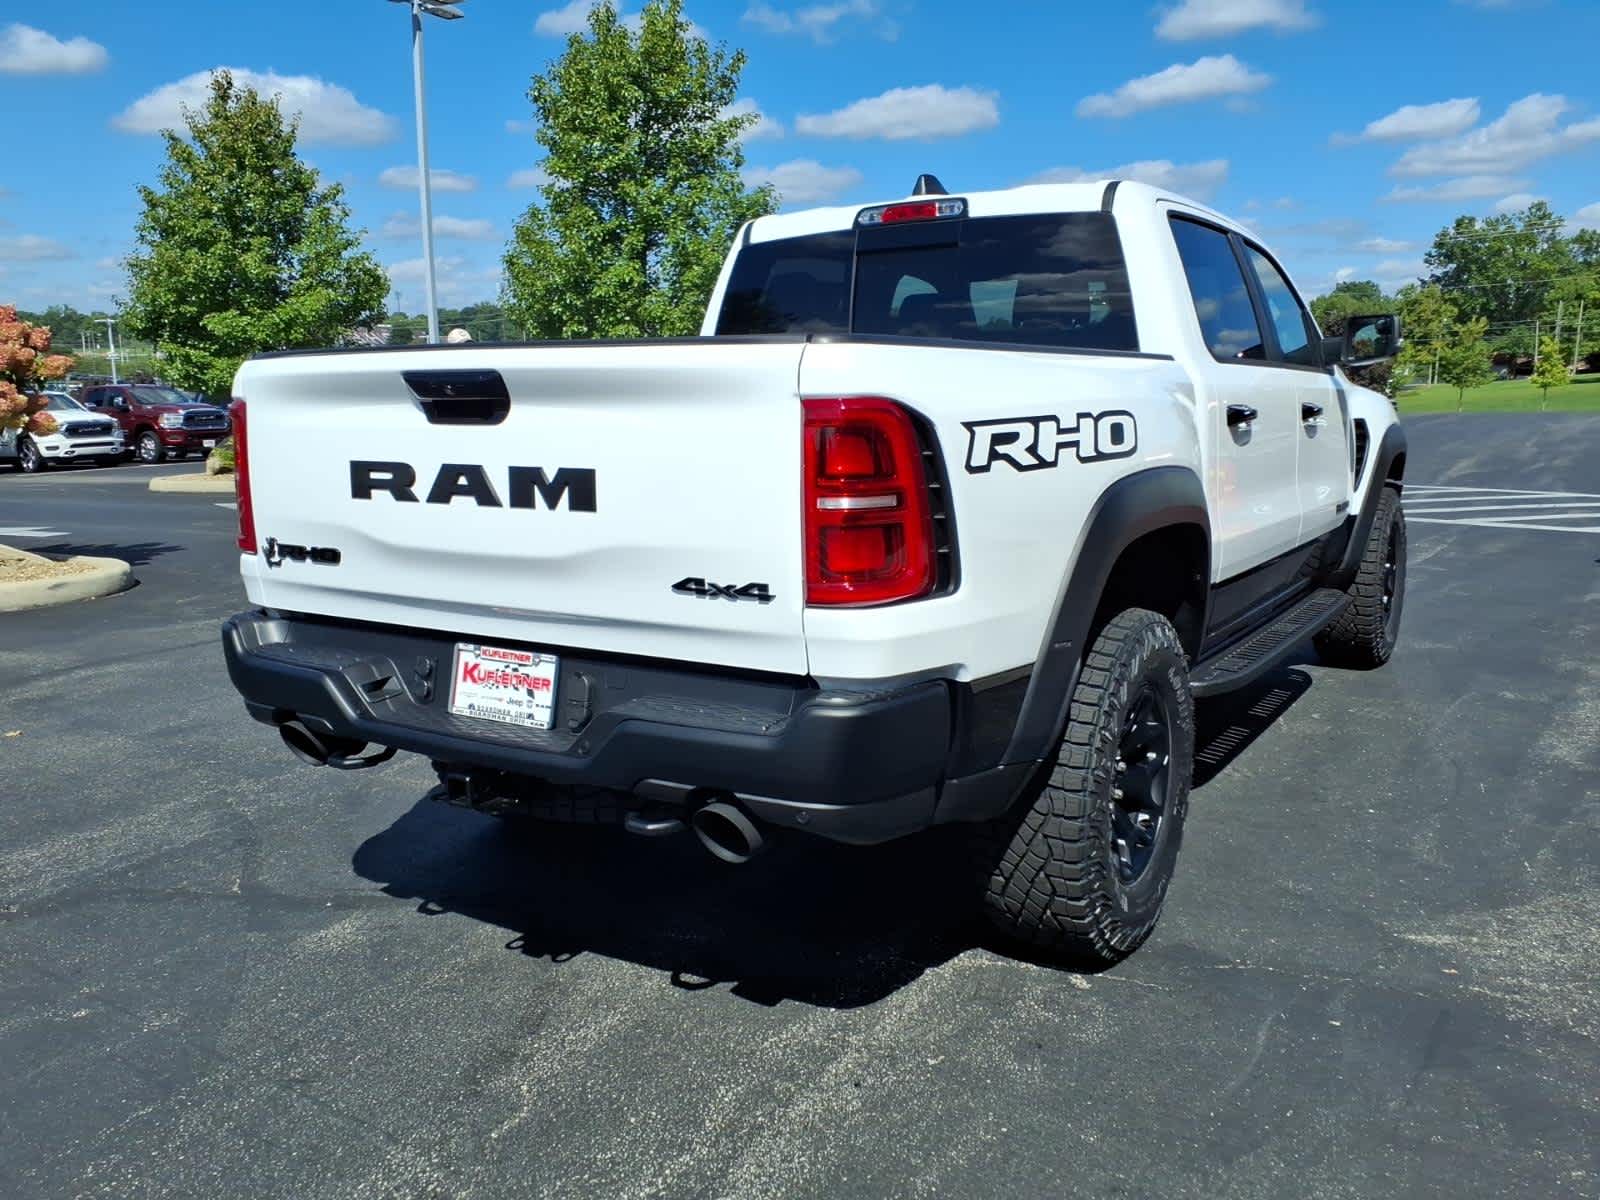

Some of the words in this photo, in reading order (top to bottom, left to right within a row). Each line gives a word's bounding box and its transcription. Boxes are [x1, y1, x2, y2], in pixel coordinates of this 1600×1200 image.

[960, 410, 1138, 474] RHO
[349, 460, 597, 513] RAM
[671, 577, 776, 605] 4x4
[482, 648, 531, 662] KUFLEITNER
[463, 662, 551, 691] KUFLEITNER
[506, 697, 524, 708] Jeep
